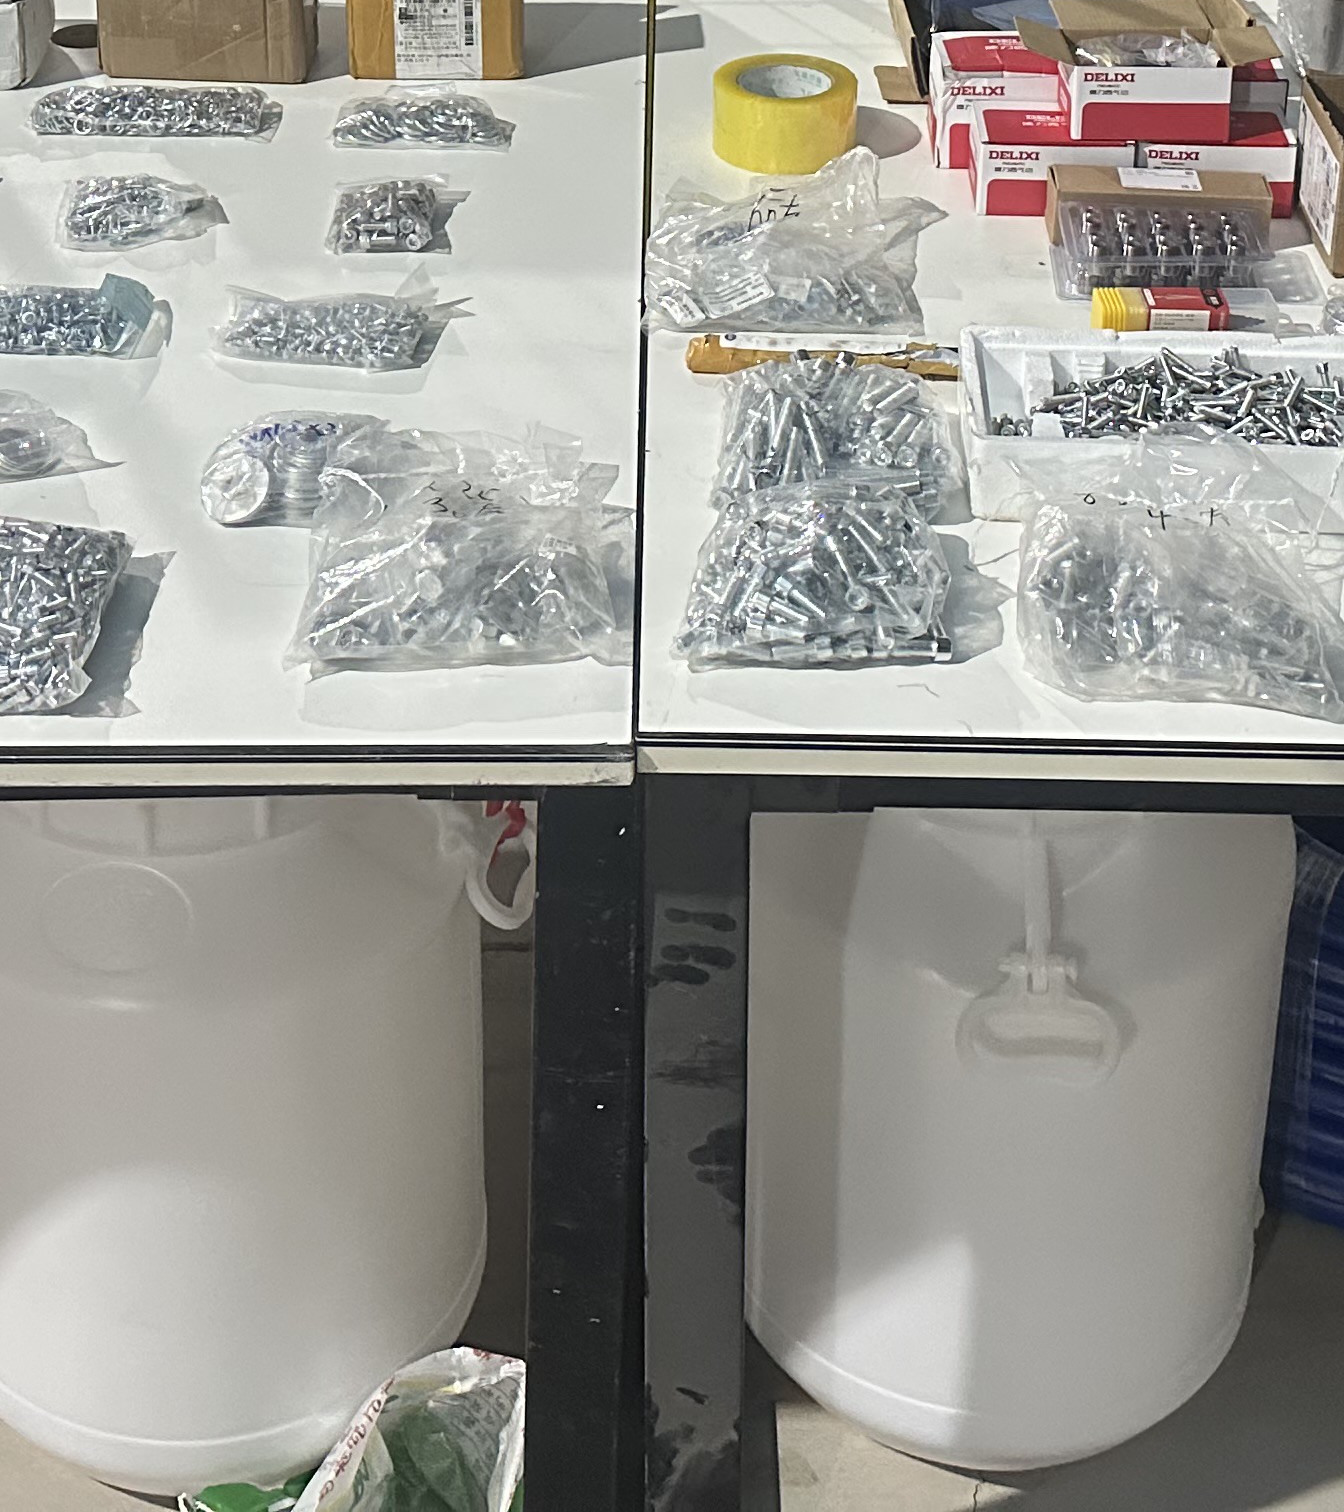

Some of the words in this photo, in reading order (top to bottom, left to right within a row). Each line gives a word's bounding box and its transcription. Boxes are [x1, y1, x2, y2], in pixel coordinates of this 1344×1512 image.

[1084, 73, 1136, 83] DELIXI
[950, 86, 1006, 97] DELIXI
[989, 150, 1041, 161] DELIXI
[1148, 149, 1200, 161] DELIXI
